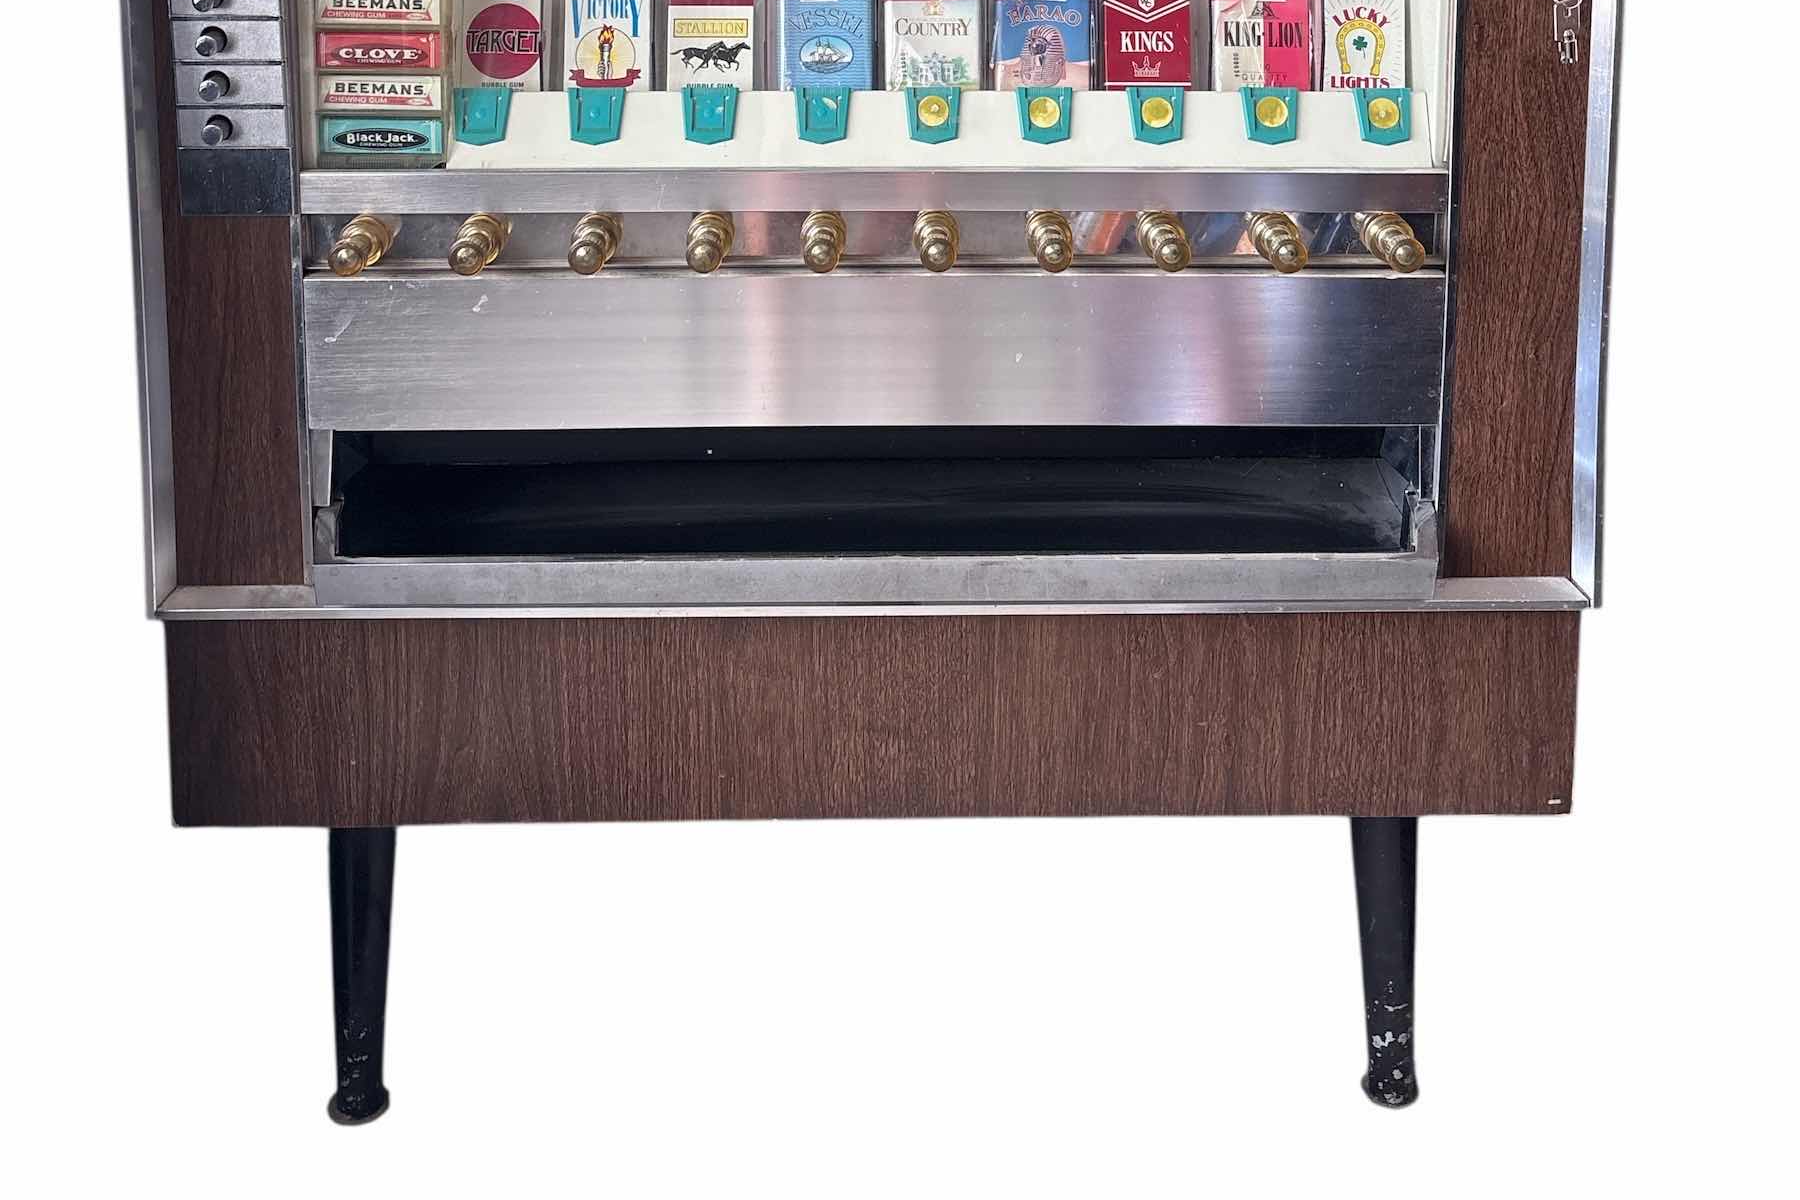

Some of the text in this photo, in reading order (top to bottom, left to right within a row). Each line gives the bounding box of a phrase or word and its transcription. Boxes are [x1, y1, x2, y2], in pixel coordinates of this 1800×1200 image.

[326, 10, 365, 18] CHEWING
[1332, 6, 1391, 28] LUCKY
[675, 22, 746, 35] STALLION
[788, 8, 864, 38] VESSEL
[895, 17, 972, 36] COUNTRY
[466, 28, 540, 54] TARGET
[1119, 30, 1175, 53] KINGS
[339, 48, 419, 60] CLOVE
[334, 82, 424, 96] BEEMANS
[1330, 75, 1391, 89] LIGHTS
[346, 133, 415, 144] Black Jack
